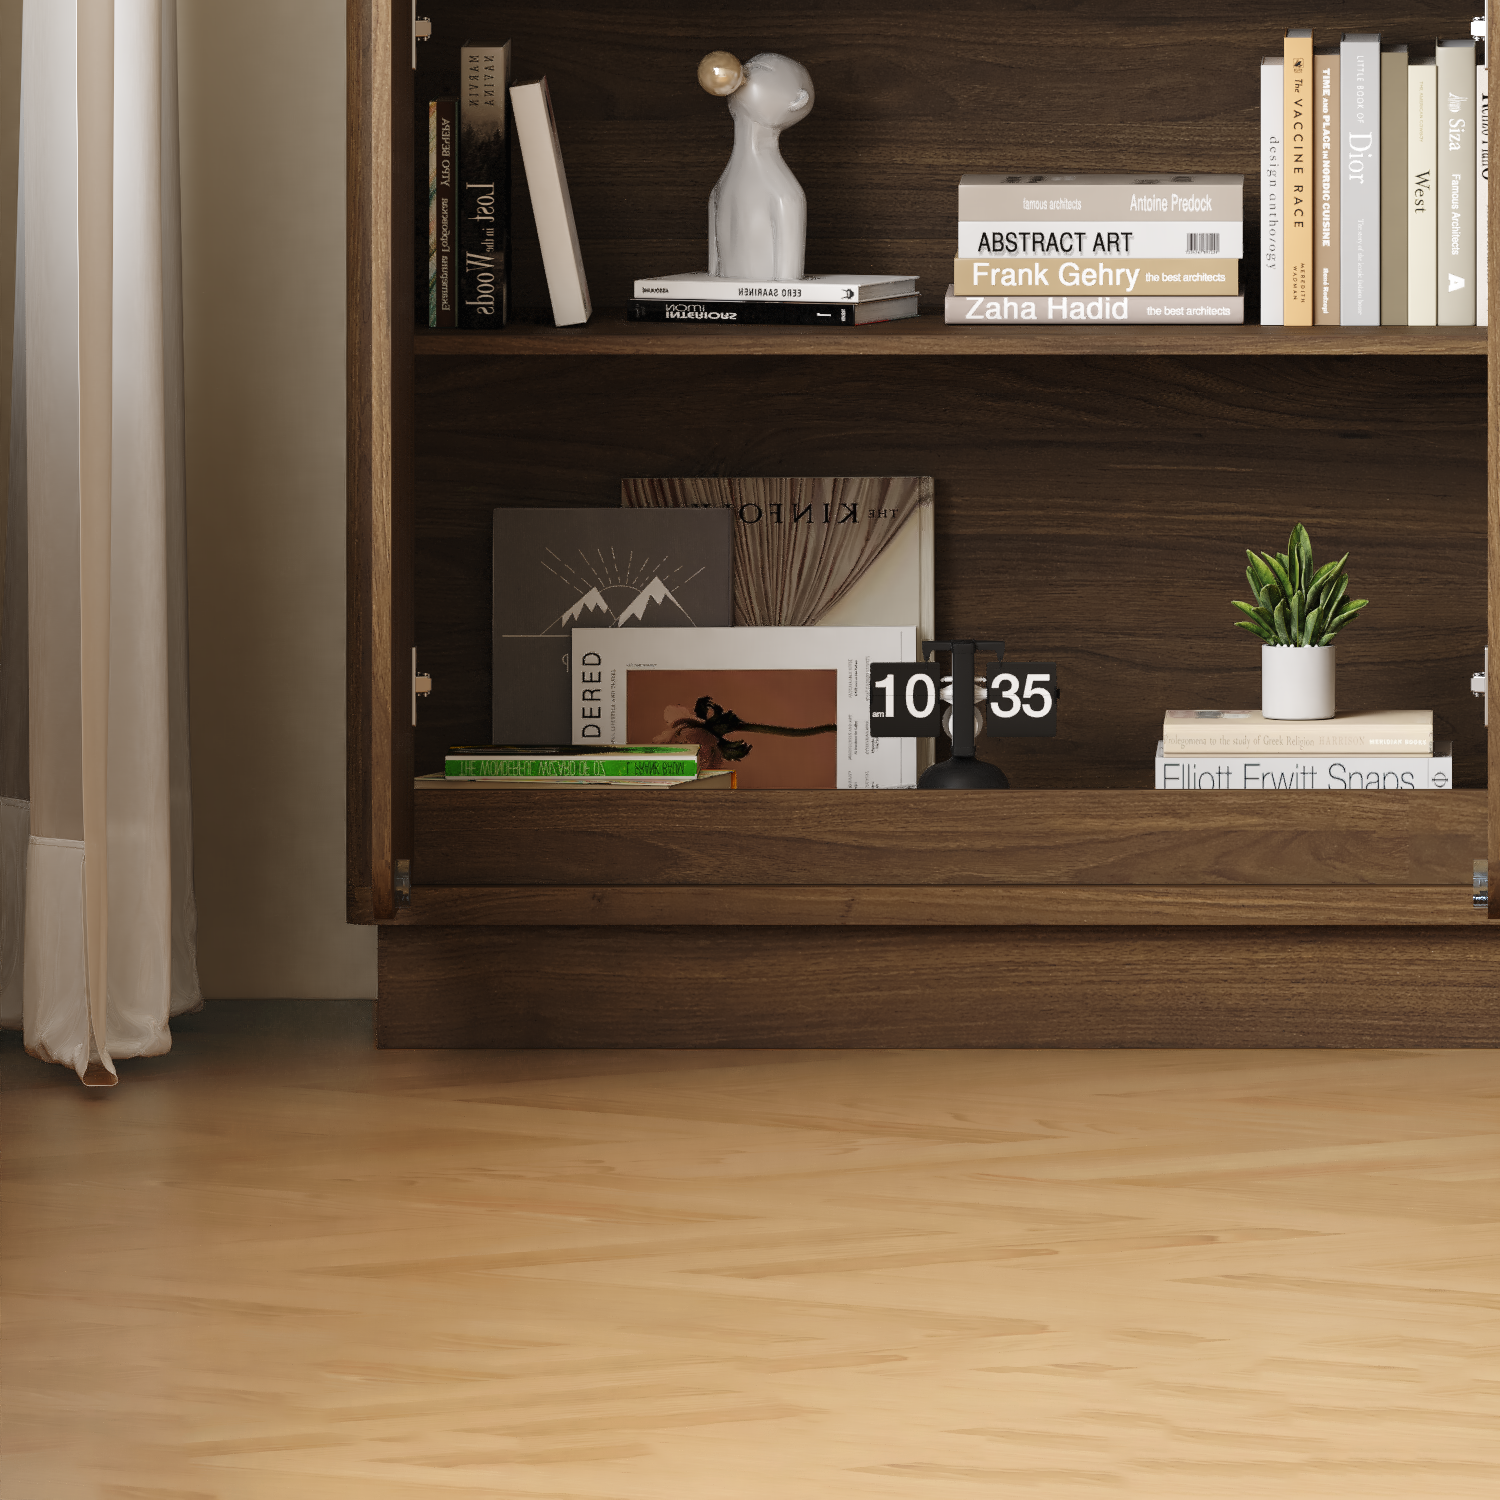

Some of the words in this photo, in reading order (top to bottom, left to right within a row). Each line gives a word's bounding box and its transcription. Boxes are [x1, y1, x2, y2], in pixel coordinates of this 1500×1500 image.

[1322, 68, 1331, 96] TIME
[1356, 55, 1364, 81] LITTLE
[1294, 79, 1303, 93] The
[1356, 85, 1364, 109] BOOK
[1322, 115, 1331, 150] PLACE
[1356, 112, 1364, 124] OF
[1293, 99, 1303, 174] VACCINE
[1449, 118, 1466, 151] Siza
[1267, 136, 1279, 187] design
[1348, 131, 1373, 184] Dior
[1322, 160, 1331, 201] NORDIC
[1414, 169, 1430, 214] West
[1451, 174, 1461, 209] Famous
[1023, 197, 1047, 210] famous
[1049, 197, 1081, 210] architects
[1130, 194, 1168, 212] Antoine
[1171, 194, 1212, 212] Predock
[1293, 185, 1304, 228] RACE
[1322, 203, 1331, 247] CUISINE
[1451, 212, 1461, 255] Architects
[978, 232, 1086, 253] ABSTRACT
[1093, 232, 1133, 253] ART
[973, 262, 1049, 286] Frank
[1058, 262, 1140, 292] Gehry
[1145, 272, 1160, 282] the
[1162, 272, 1181, 282] best
[1183, 272, 1226, 282] architects
[965, 297, 1038, 320] Zaha
[1048, 297, 1129, 320] Hadid
[1147, 306, 1162, 316] the
[1163, 306, 1184, 316] best
[1186, 306, 1231, 316] architects
[581, 652, 602, 738] DERED
[875, 673, 936, 718] 10
[990, 673, 1053, 718] 35
[1209, 737, 1217, 746] to
[1219, 735, 1231, 746] the
[1232, 735, 1251, 750] study
[1253, 735, 1261, 746] of
[1263, 735, 1284, 746] Greek
[1286, 735, 1315, 750] Religion
[1319, 736, 1365, 746] HARRISON
[1163, 763, 1232, 789] Elliott
[1244, 763, 1317, 789] Erwitt
